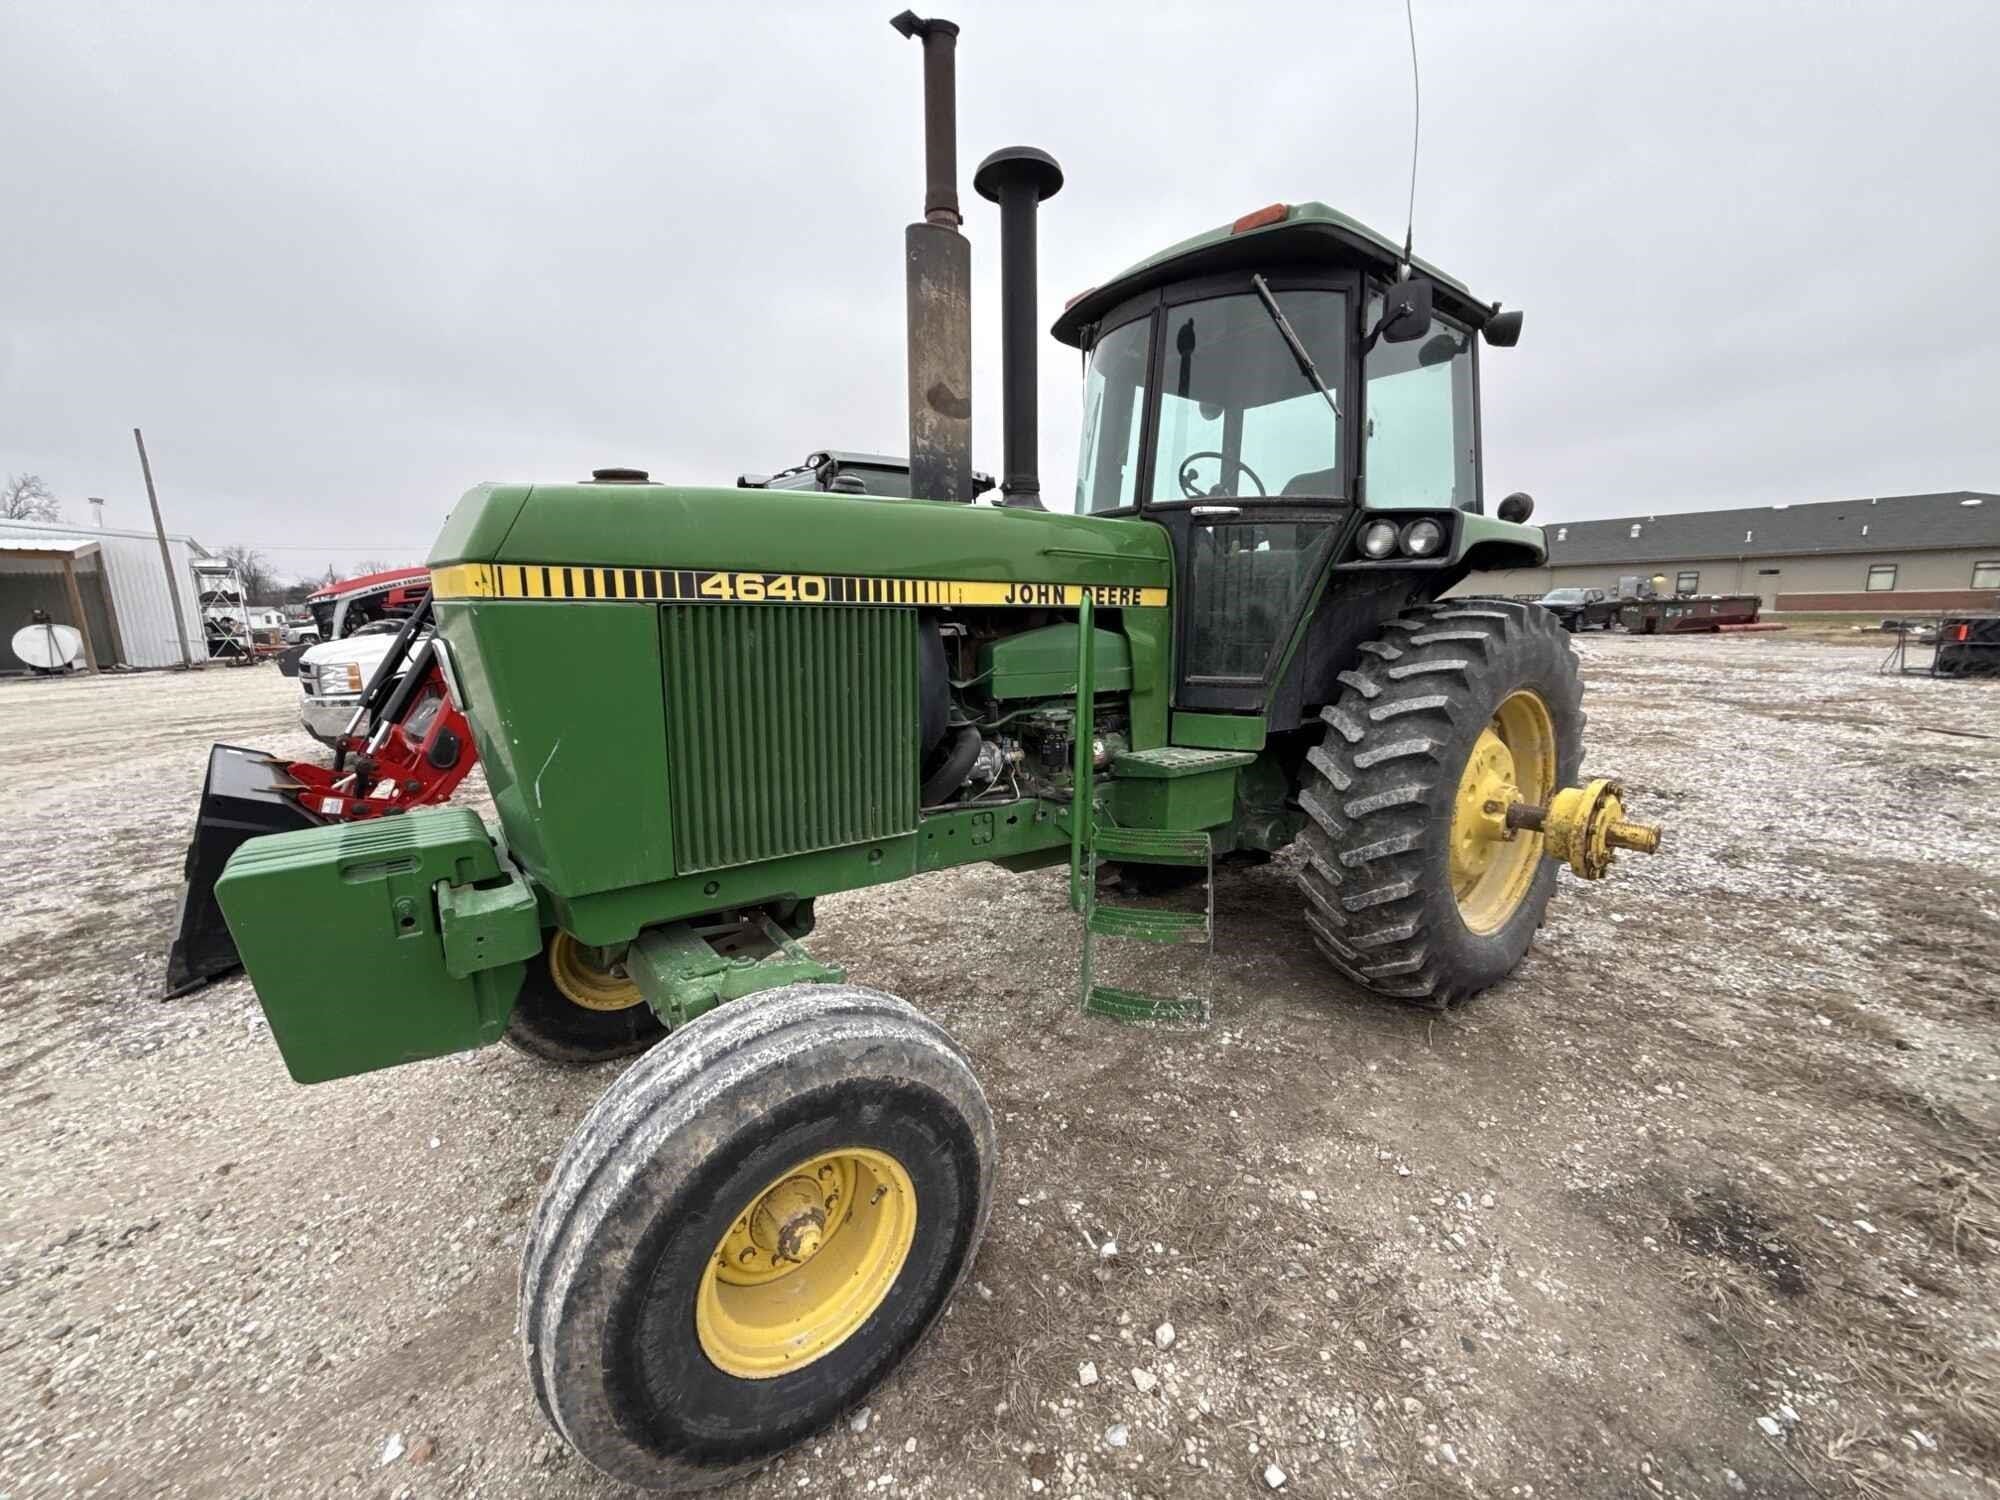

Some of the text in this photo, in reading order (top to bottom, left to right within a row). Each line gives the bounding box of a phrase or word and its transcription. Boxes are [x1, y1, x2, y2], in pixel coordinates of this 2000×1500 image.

[370, 576, 431, 592] MASSEY FERGUS
[700, 572, 826, 602] 4640
[1004, 583, 1065, 604] JOHN
